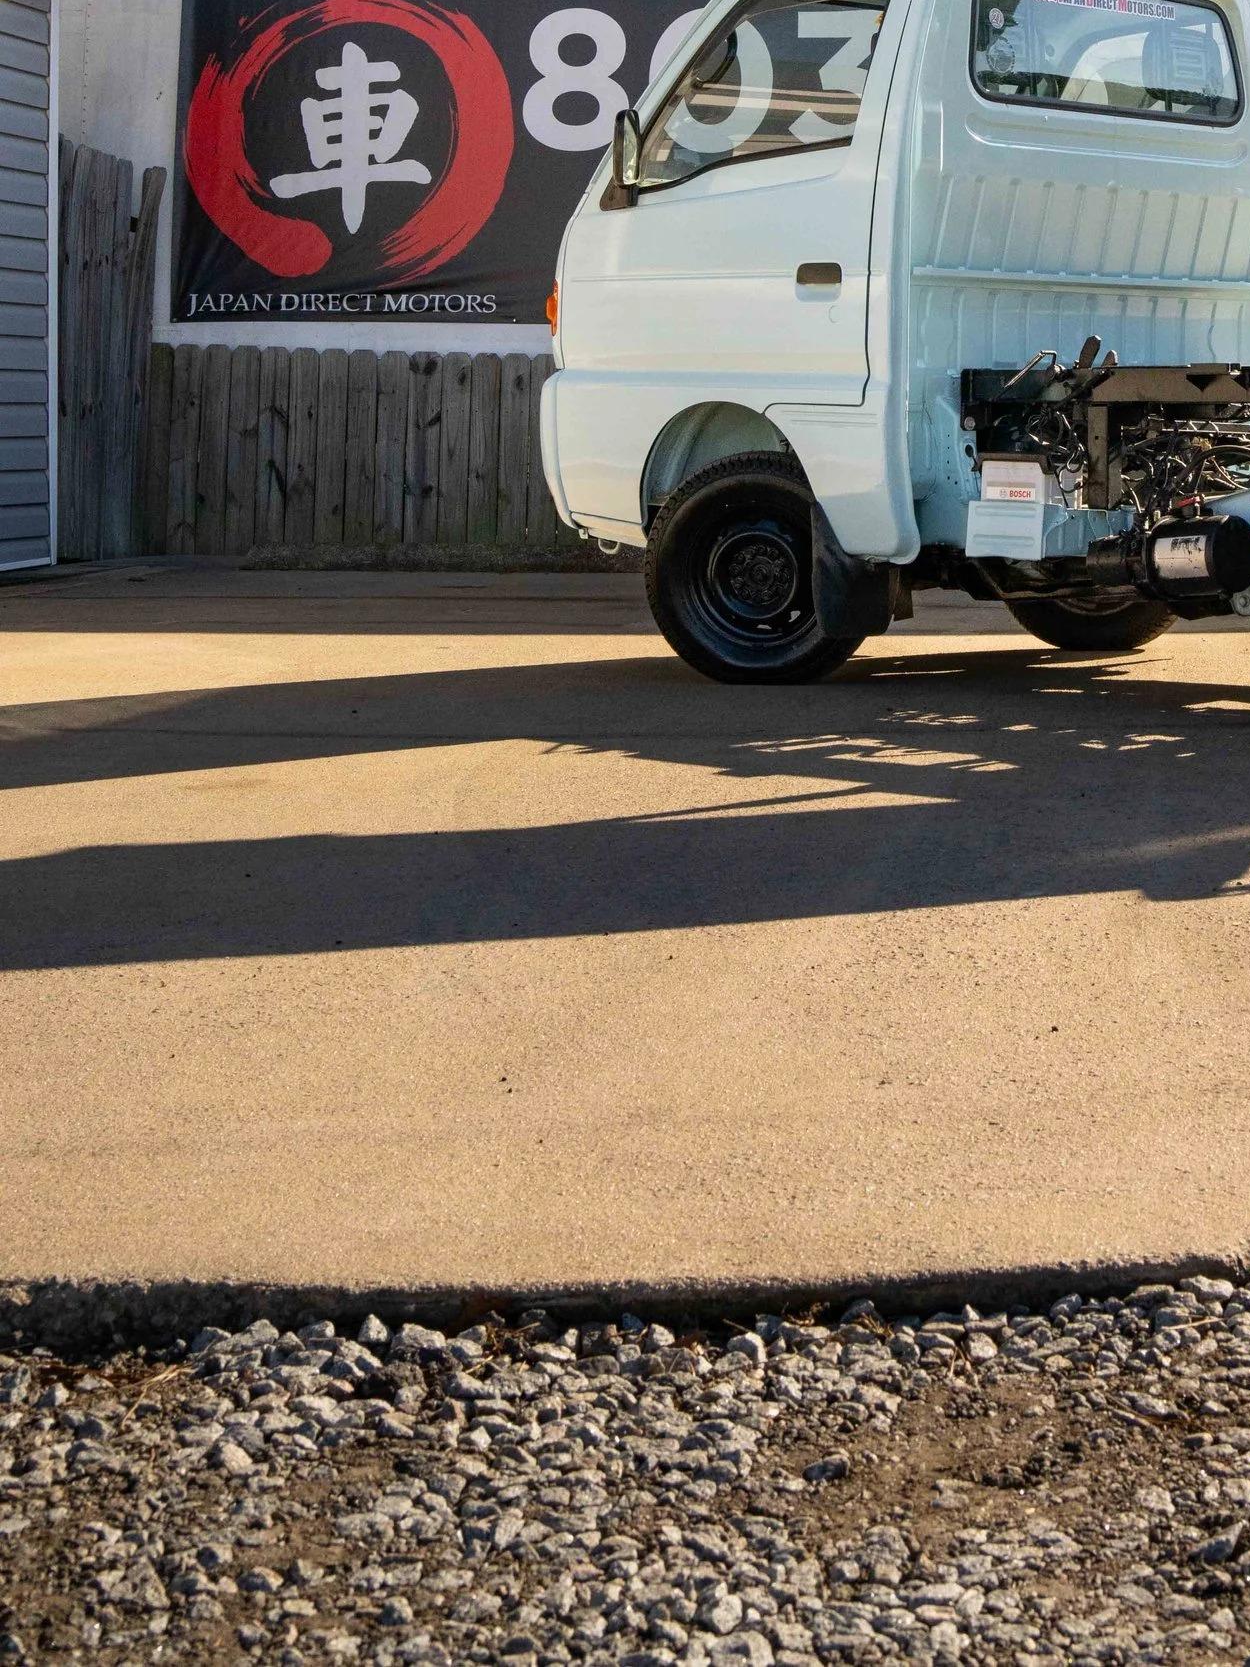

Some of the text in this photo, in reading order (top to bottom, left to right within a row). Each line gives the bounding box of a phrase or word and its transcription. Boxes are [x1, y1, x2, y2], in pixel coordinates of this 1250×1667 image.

[269, 41, 433, 235] 車
[187, 293, 497, 317] JAPAN DIRECT MOTORS
[1009, 490, 1031, 498] BOSCH
